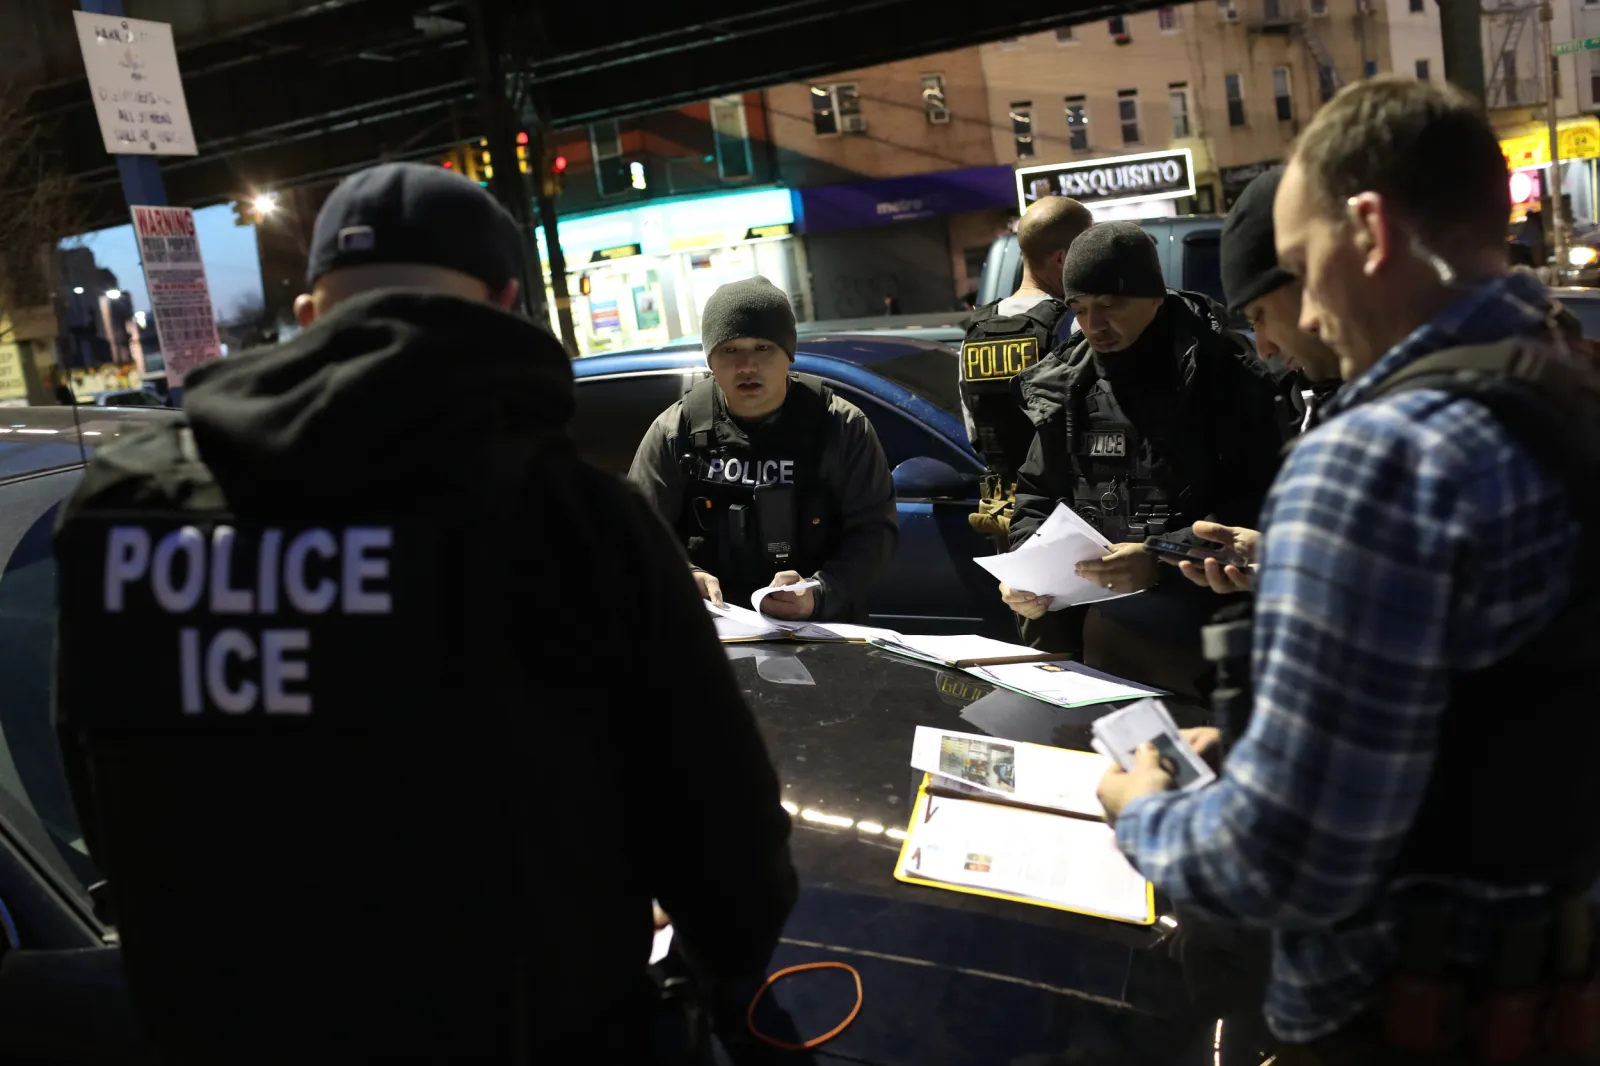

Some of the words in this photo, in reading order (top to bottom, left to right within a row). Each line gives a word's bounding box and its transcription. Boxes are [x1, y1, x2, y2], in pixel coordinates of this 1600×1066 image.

[1058, 159, 1181, 196] EXQUISITO
[134, 207, 196, 236] WARNING
[967, 342, 1032, 378] POLICE
[707, 457, 795, 486] POLICE
[104, 525, 393, 614] POLICE
[179, 627, 312, 714] ICE
